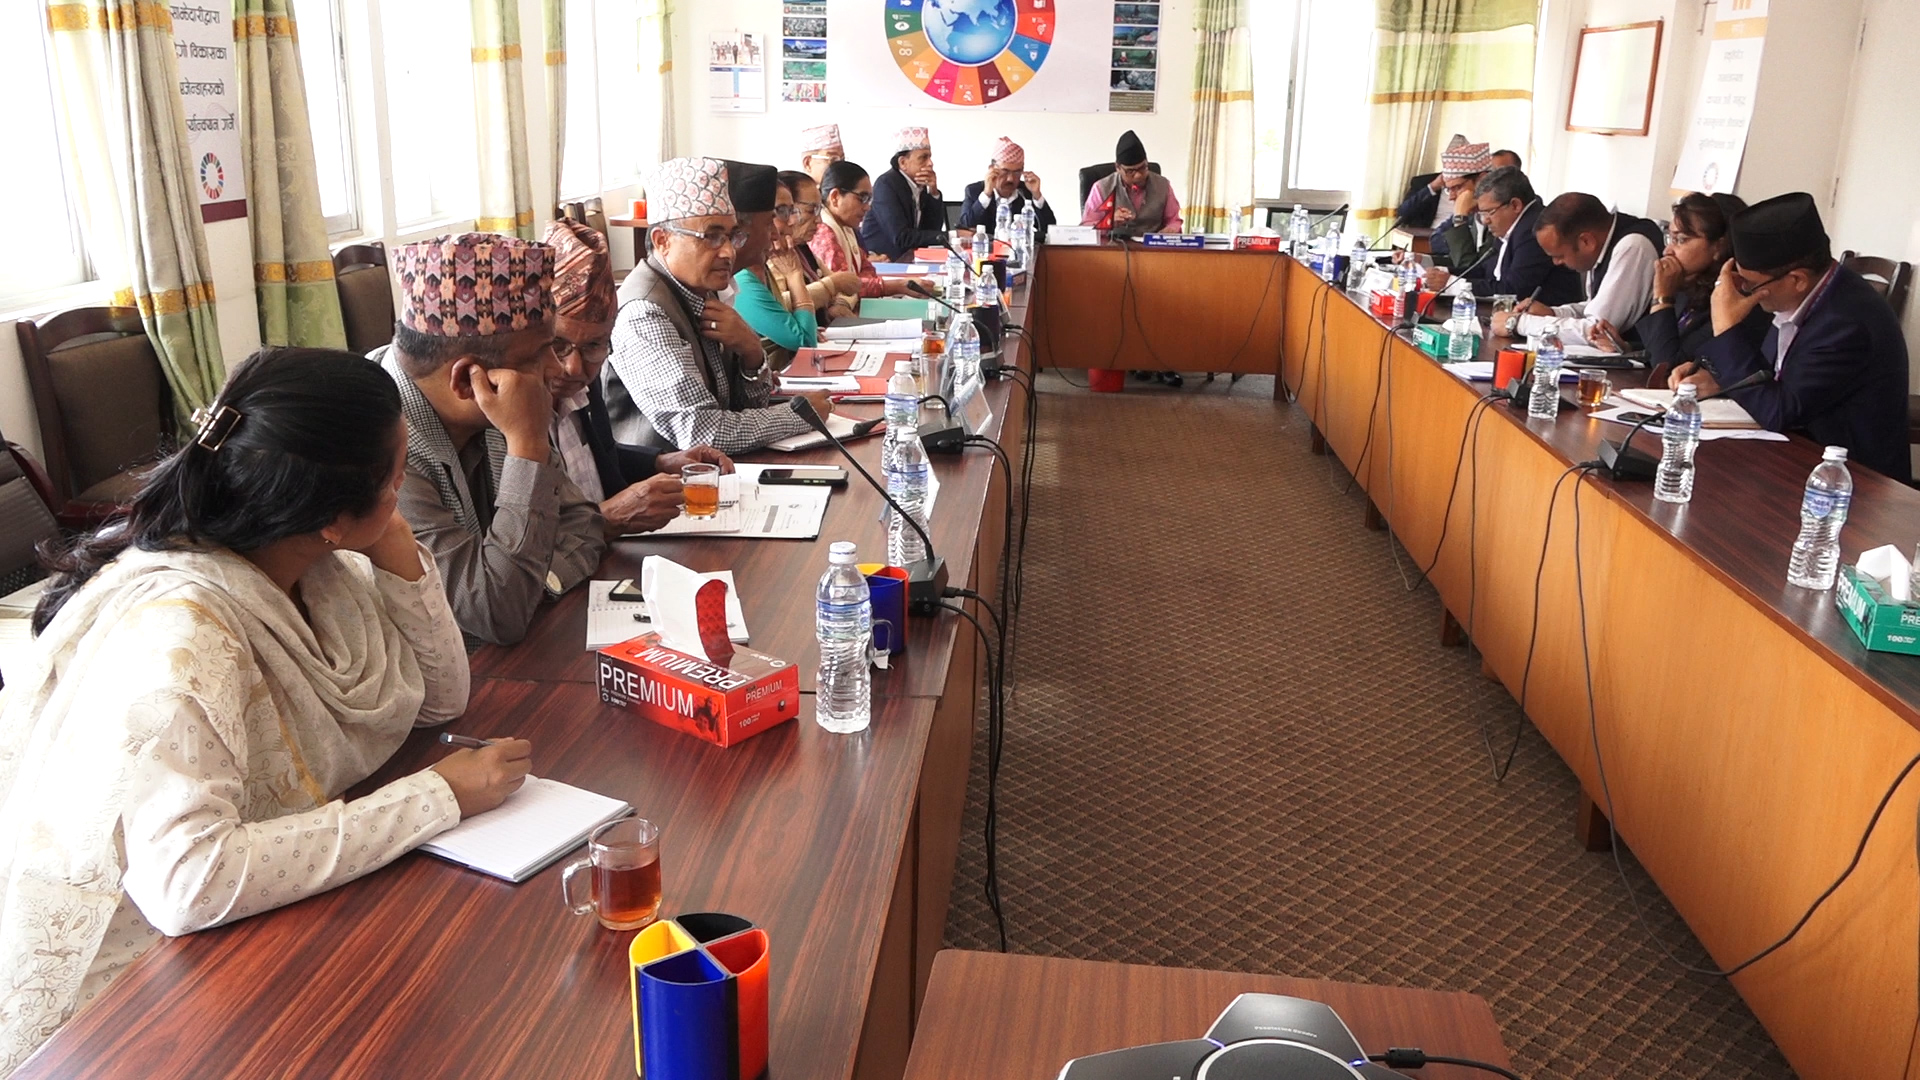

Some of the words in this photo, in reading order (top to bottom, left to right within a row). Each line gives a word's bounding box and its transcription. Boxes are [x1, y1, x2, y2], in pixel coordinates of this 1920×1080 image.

[1236, 236, 1271, 246] PREMIUM
[633, 647, 747, 689] PREMIUM
[600, 662, 695, 719] PREMIUM
[745, 679, 783, 704] PREMIUM
[739, 716, 752, 729] 100
